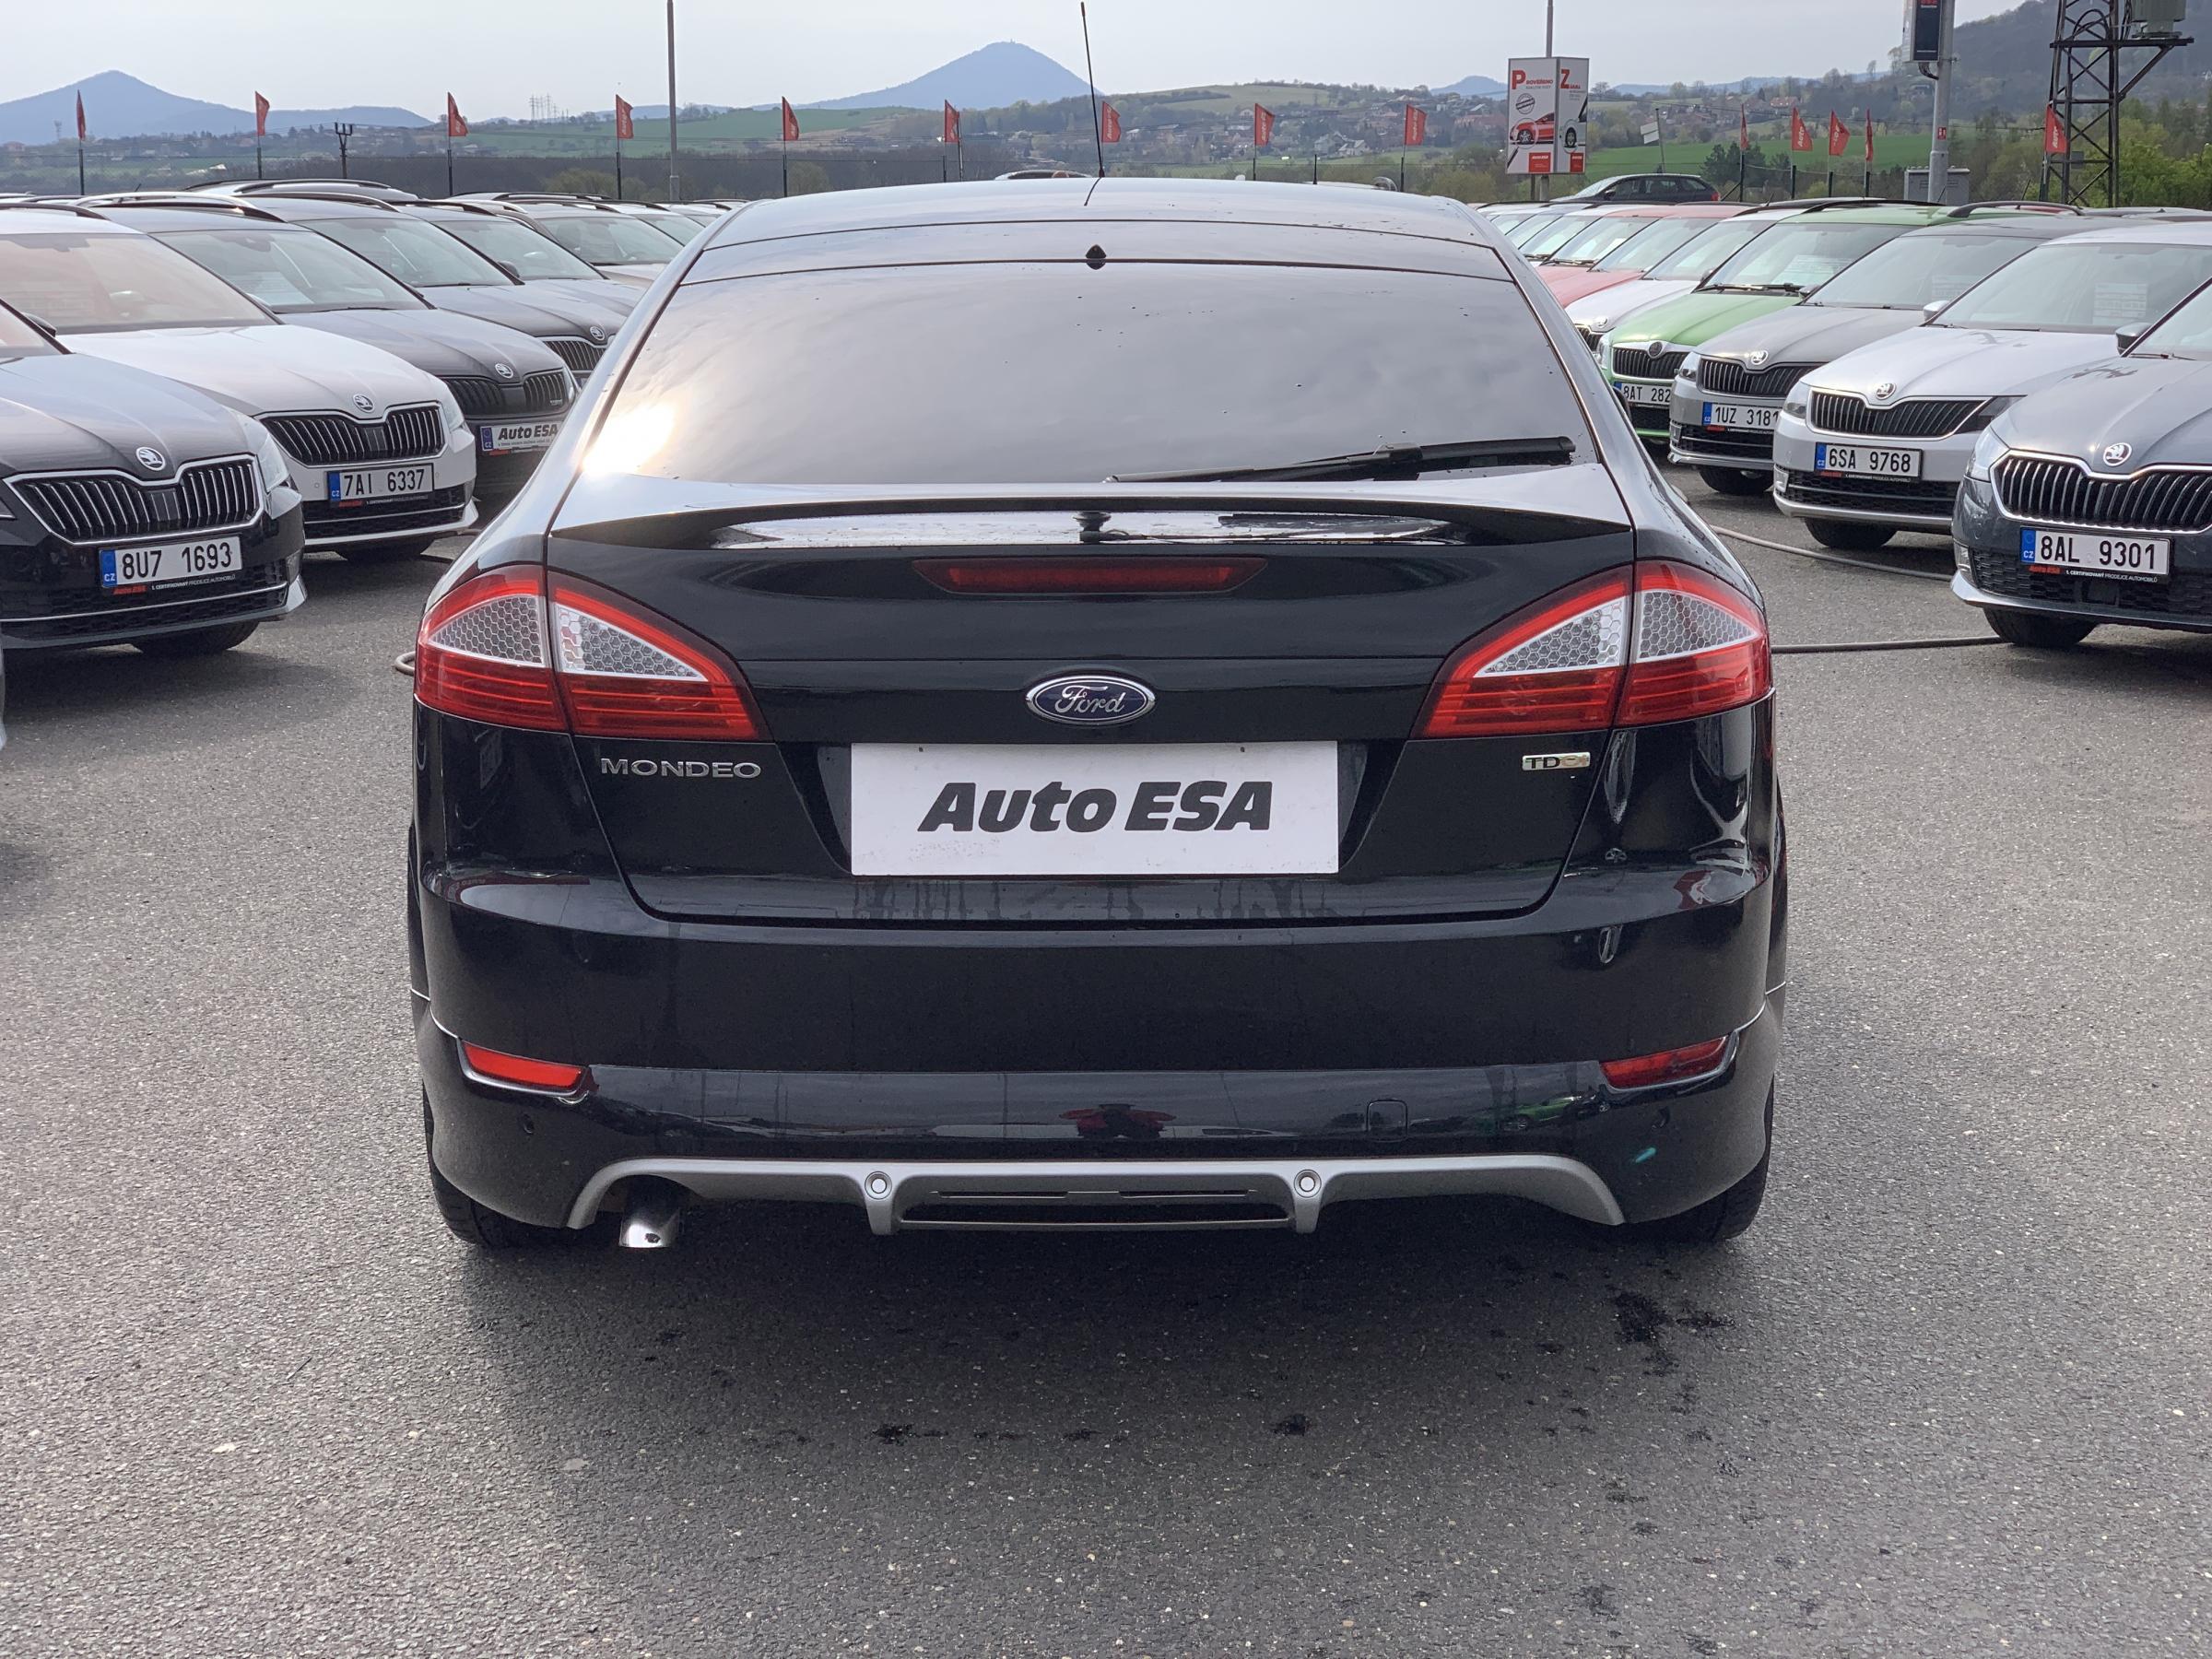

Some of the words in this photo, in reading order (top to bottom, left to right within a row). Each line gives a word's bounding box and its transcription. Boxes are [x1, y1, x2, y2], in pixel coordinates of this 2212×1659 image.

[1623, 385, 1642, 400] 8AT
[1715, 406, 1737, 424] 1UZ
[499, 426, 532, 441] Auto
[534, 423, 559, 438] ESA
[1829, 448, 1856, 469] 6SA
[1869, 451, 1911, 473] 9768
[387, 468, 426, 491] 6337
[122, 550, 162, 580] 8U7
[182, 542, 232, 573] 1693
[2023, 550, 2035, 559] CZ
[2041, 535, 2080, 563] 8AL
[2099, 540, 2156, 570] 9301
[103, 572, 116, 582] CZ
[1053, 684, 1126, 715] Ford
[601, 758, 761, 779] MONDEO
[917, 781, 1118, 833] Auto
[1124, 781, 1273, 831] ESA
